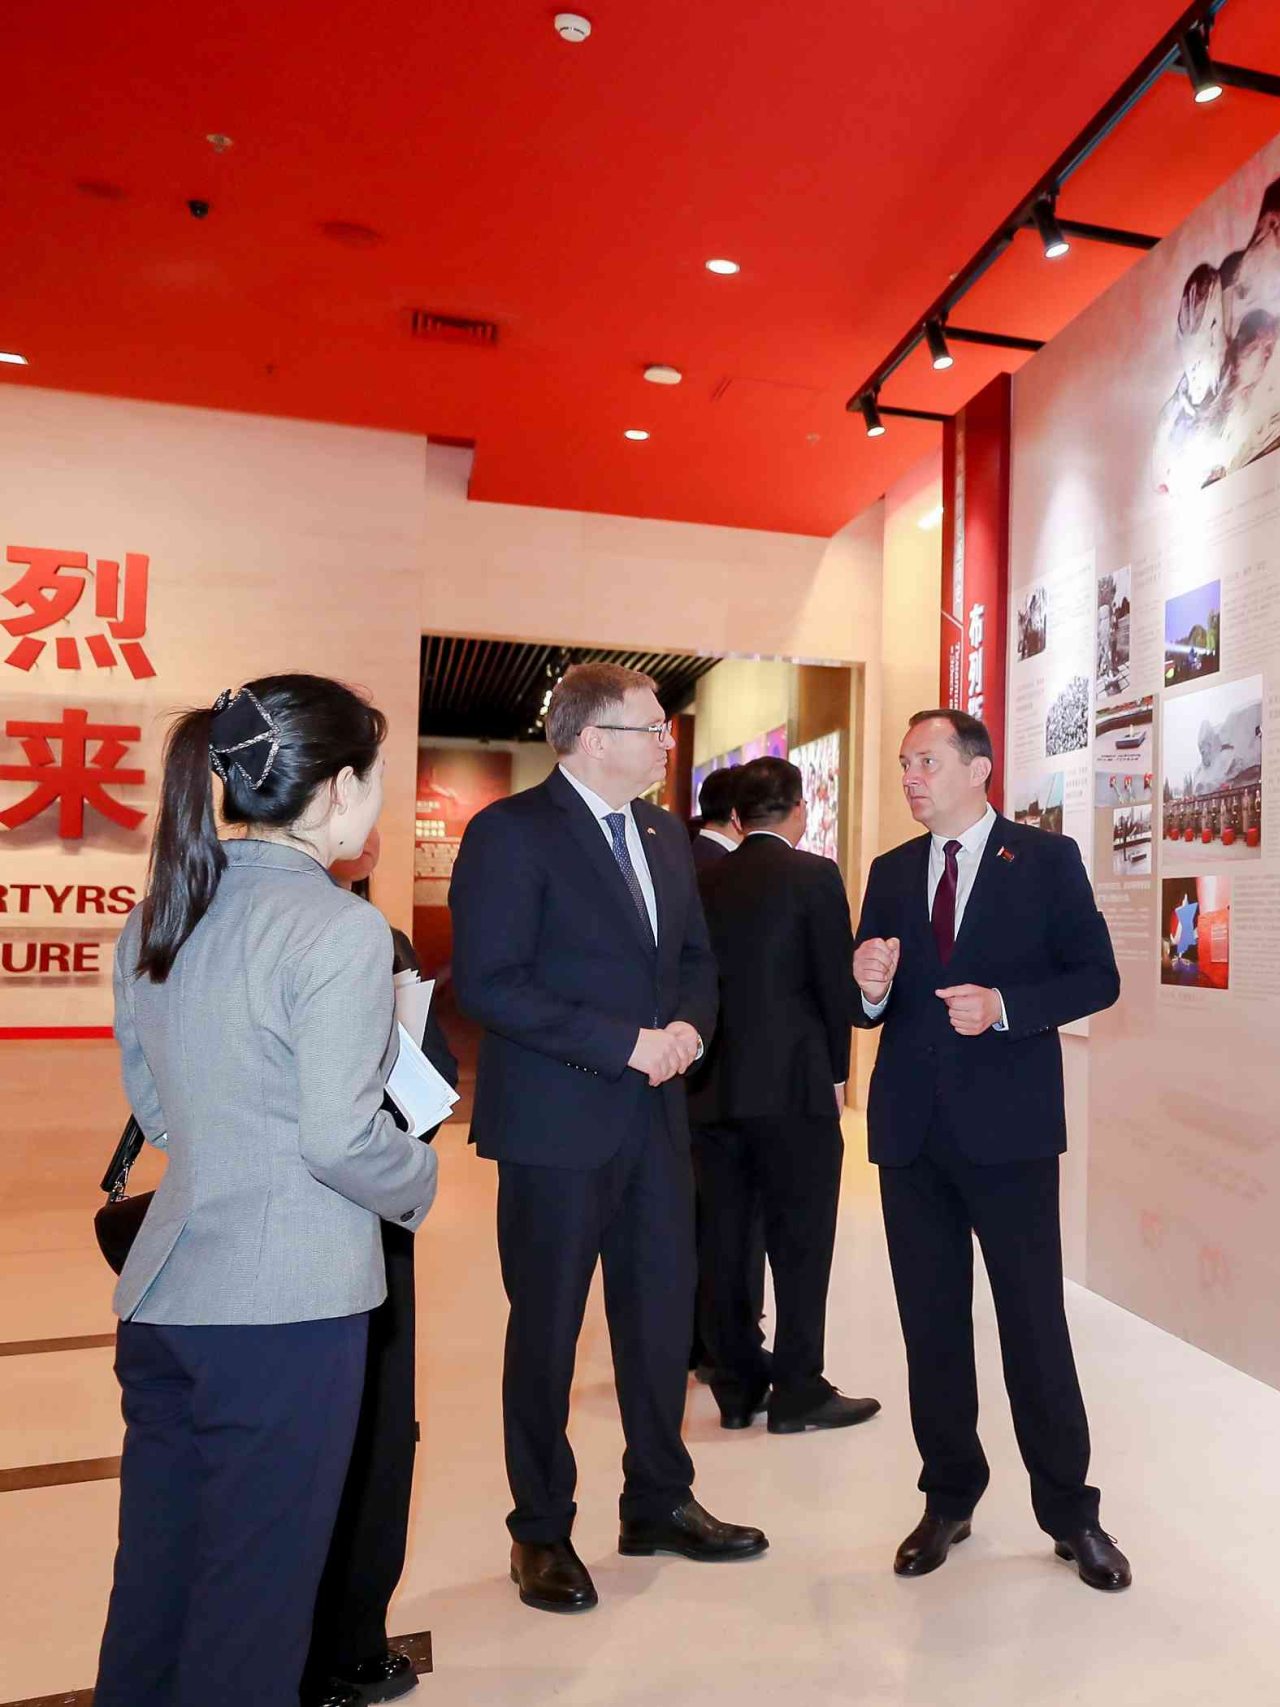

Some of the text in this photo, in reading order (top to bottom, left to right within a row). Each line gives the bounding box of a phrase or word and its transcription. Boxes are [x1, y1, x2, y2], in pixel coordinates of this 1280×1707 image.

[0, 545, 157, 679] 烈
[0, 708, 147, 838] 来
[2, 943, 100, 973] URE
